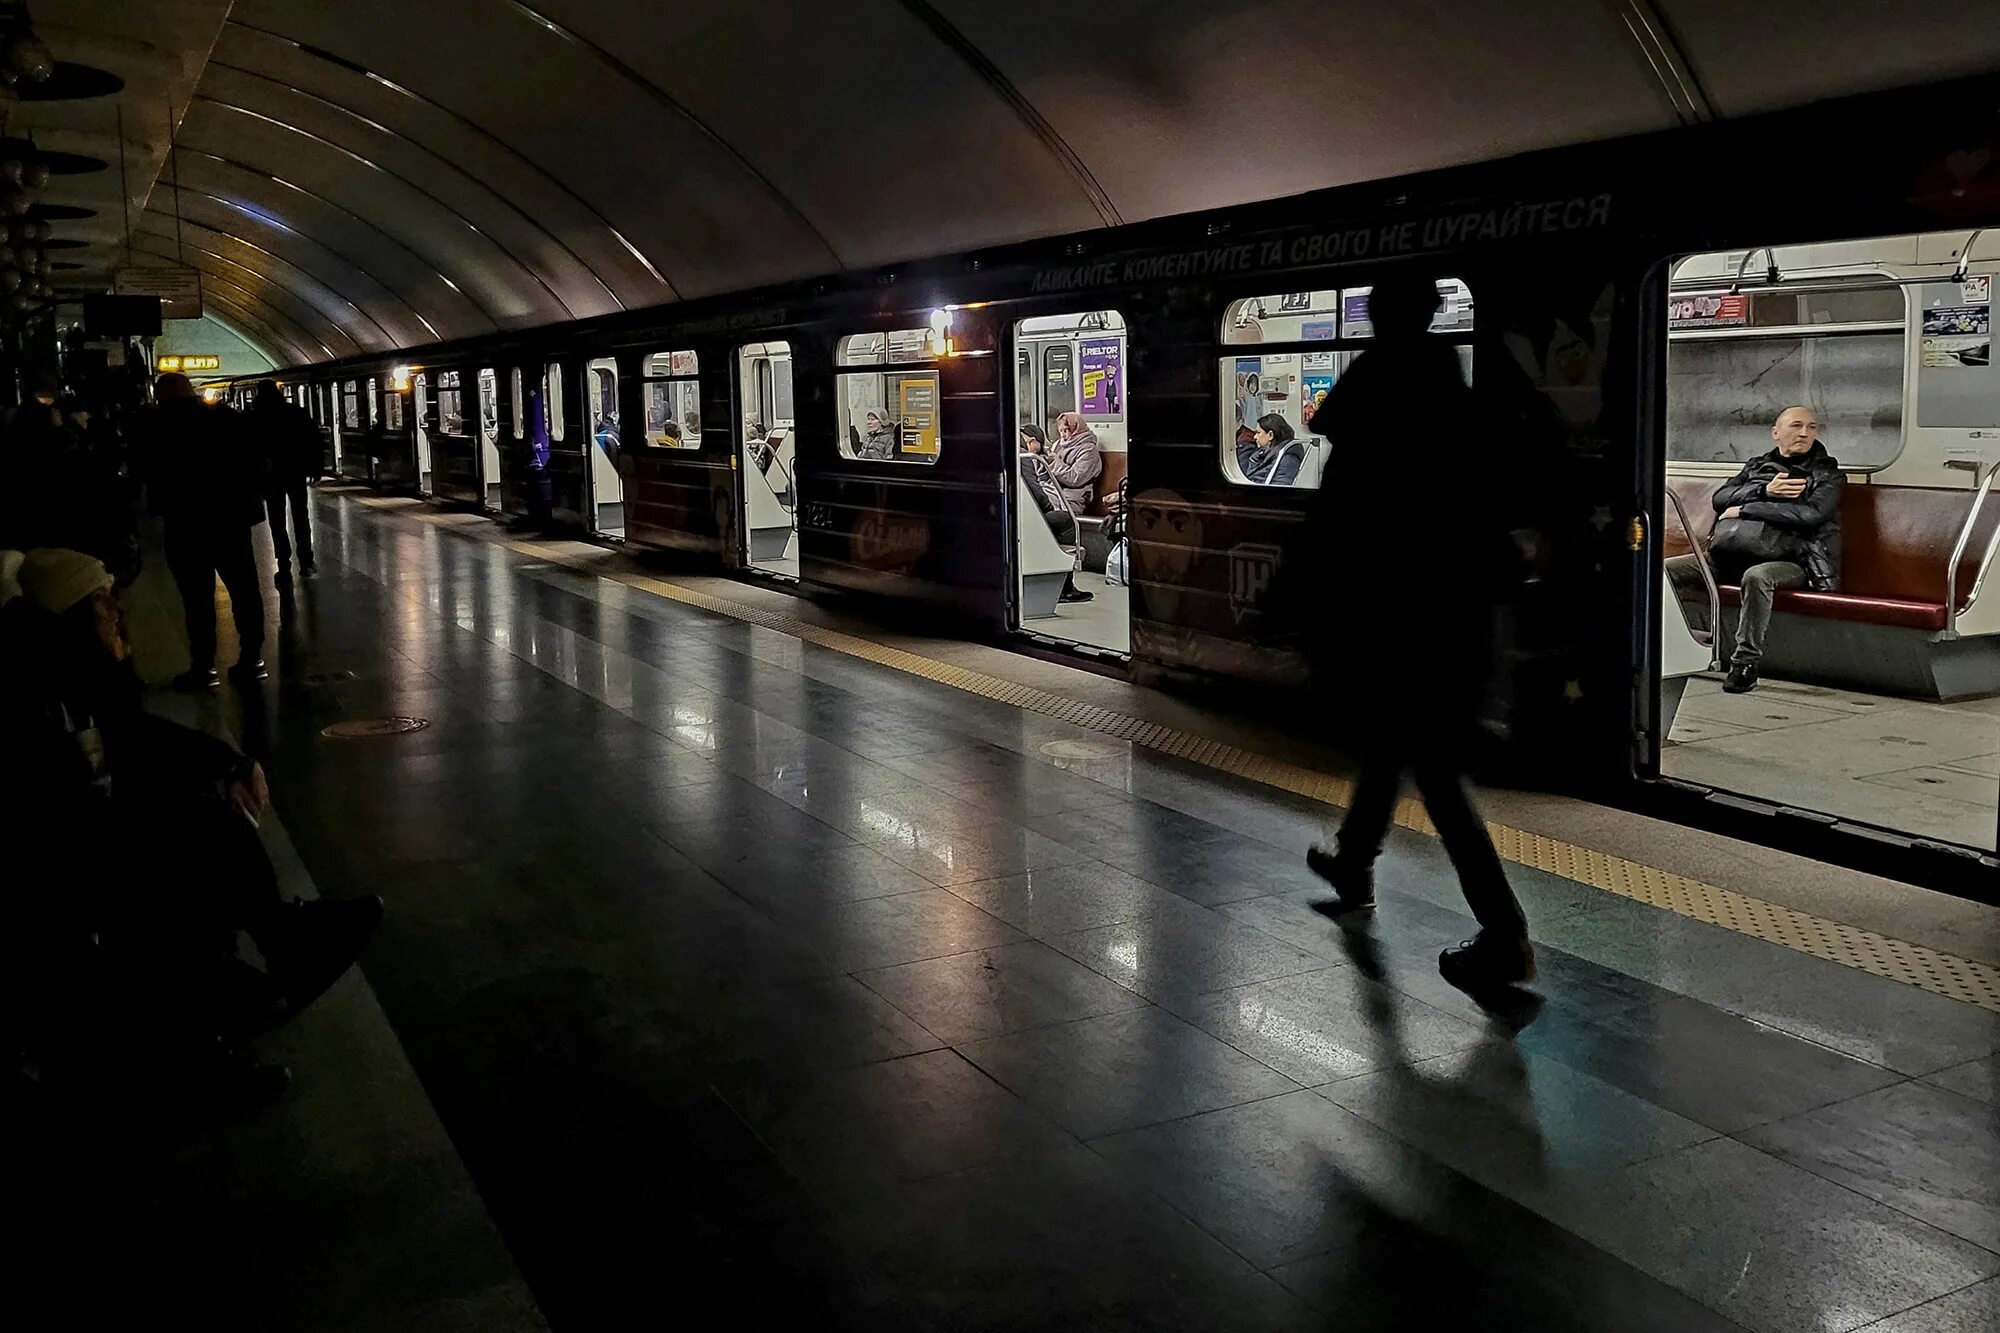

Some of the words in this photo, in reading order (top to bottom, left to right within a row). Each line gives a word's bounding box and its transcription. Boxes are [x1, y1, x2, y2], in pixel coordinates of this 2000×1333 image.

[1259, 239, 1284, 266] ТА
[1290, 227, 1371, 263] СВОГО
[1377, 220, 1418, 255] НЕ
[1421, 193, 1614, 249] ЦУРАЙТЕСЯ
